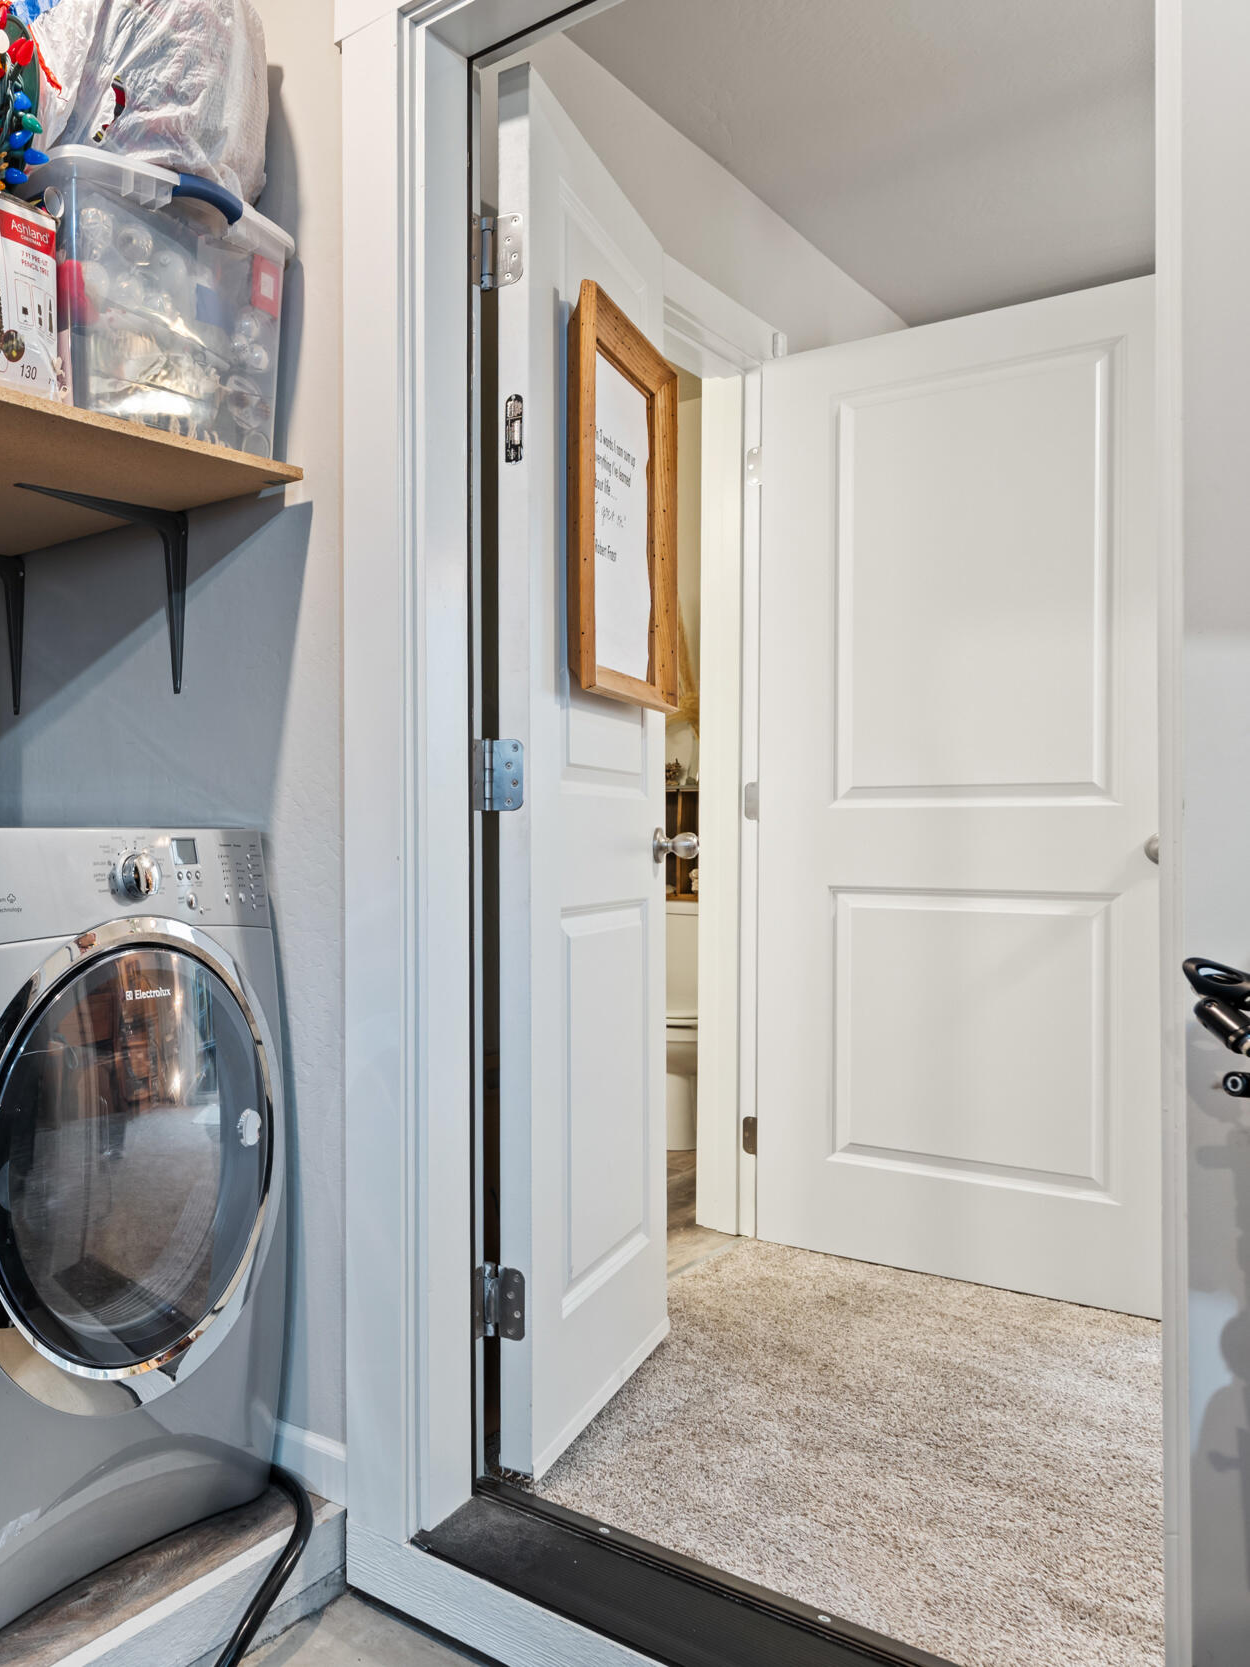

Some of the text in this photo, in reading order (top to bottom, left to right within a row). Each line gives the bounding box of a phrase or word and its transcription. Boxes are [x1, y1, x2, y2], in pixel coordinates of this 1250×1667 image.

[11, 219, 49, 244] Ashland
[20, 364, 37, 380] 130
[134, 986, 171, 1000] Electrolux
